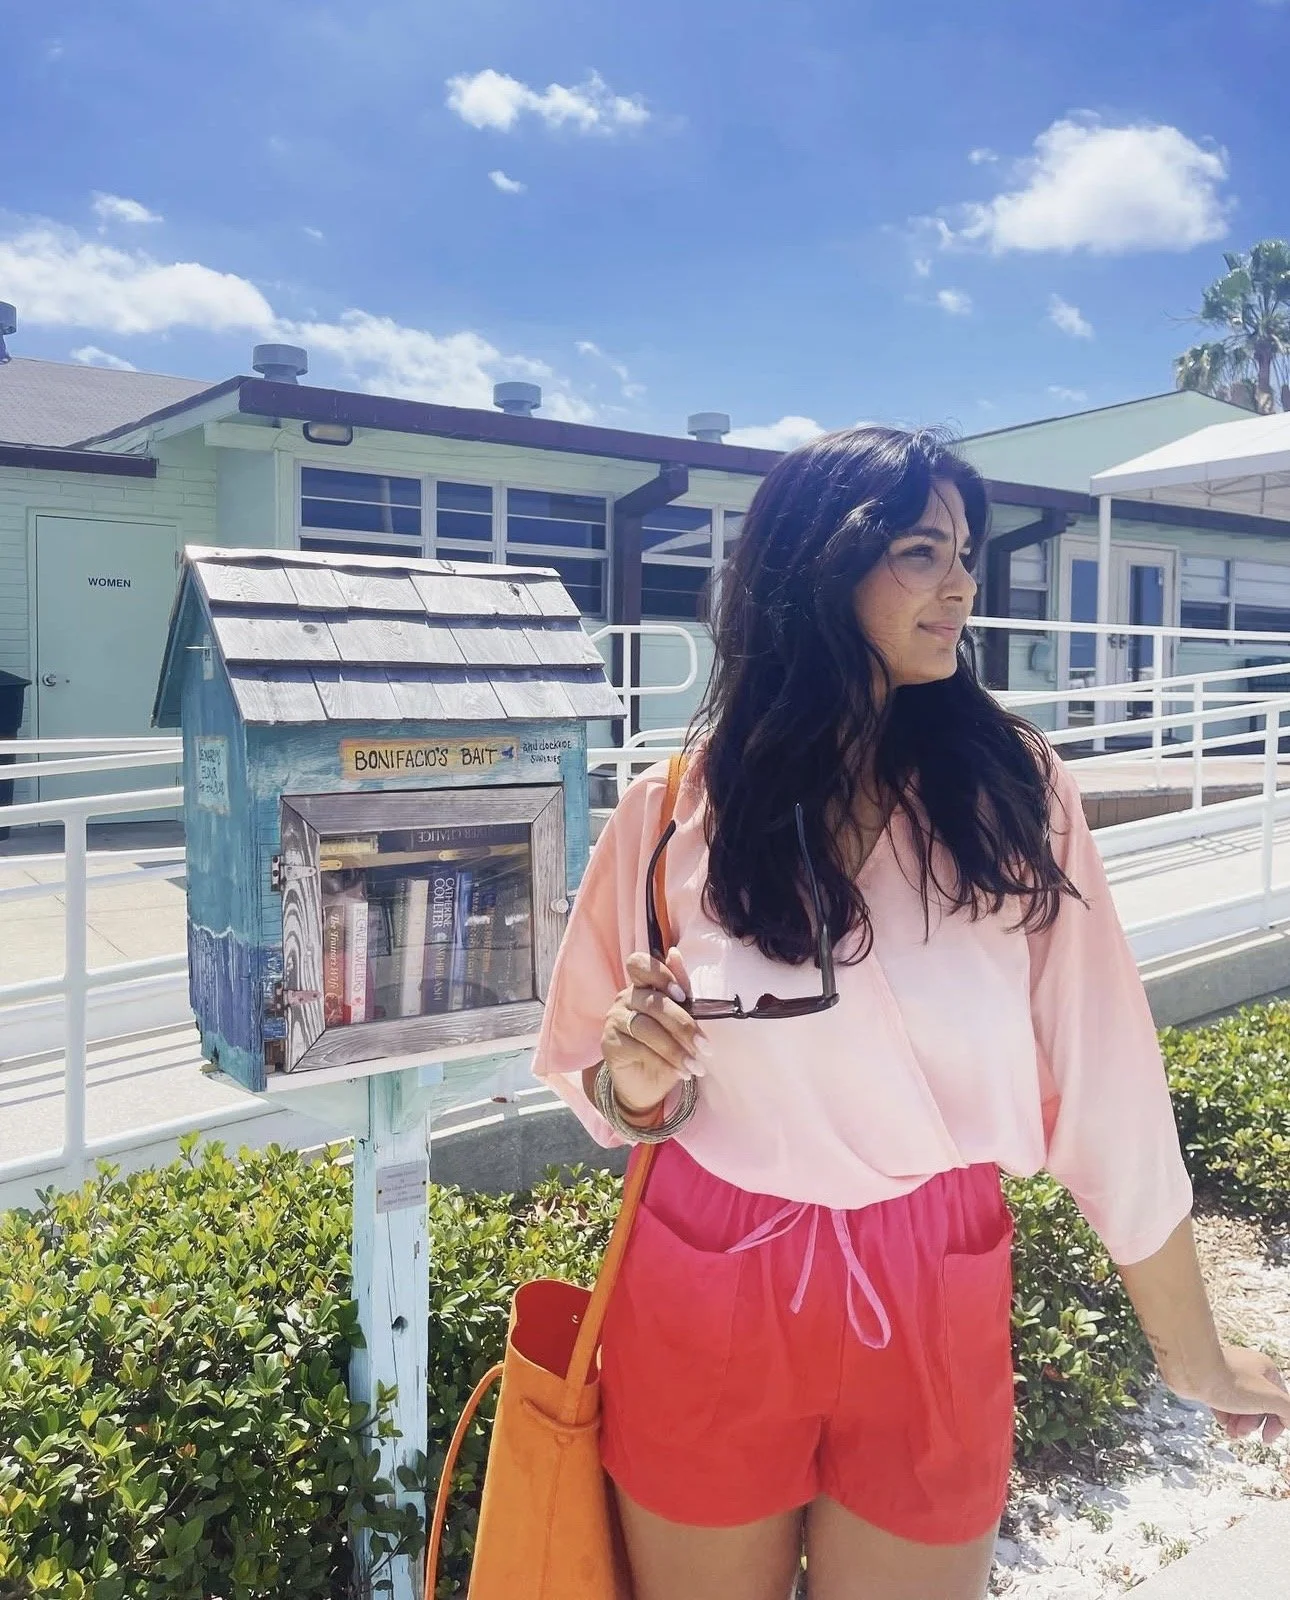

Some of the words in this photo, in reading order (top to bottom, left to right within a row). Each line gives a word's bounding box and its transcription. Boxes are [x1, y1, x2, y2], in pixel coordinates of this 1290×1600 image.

[88, 577, 131, 588] WOMEN
[354, 746, 449, 771] BONIFACIO'S
[460, 747, 499, 767] BAIT
[432, 878, 446, 928] COULTER
[443, 877, 455, 927] CATHERINE
[330, 914, 340, 929] The
[433, 946, 447, 1001] WHIPLASH
